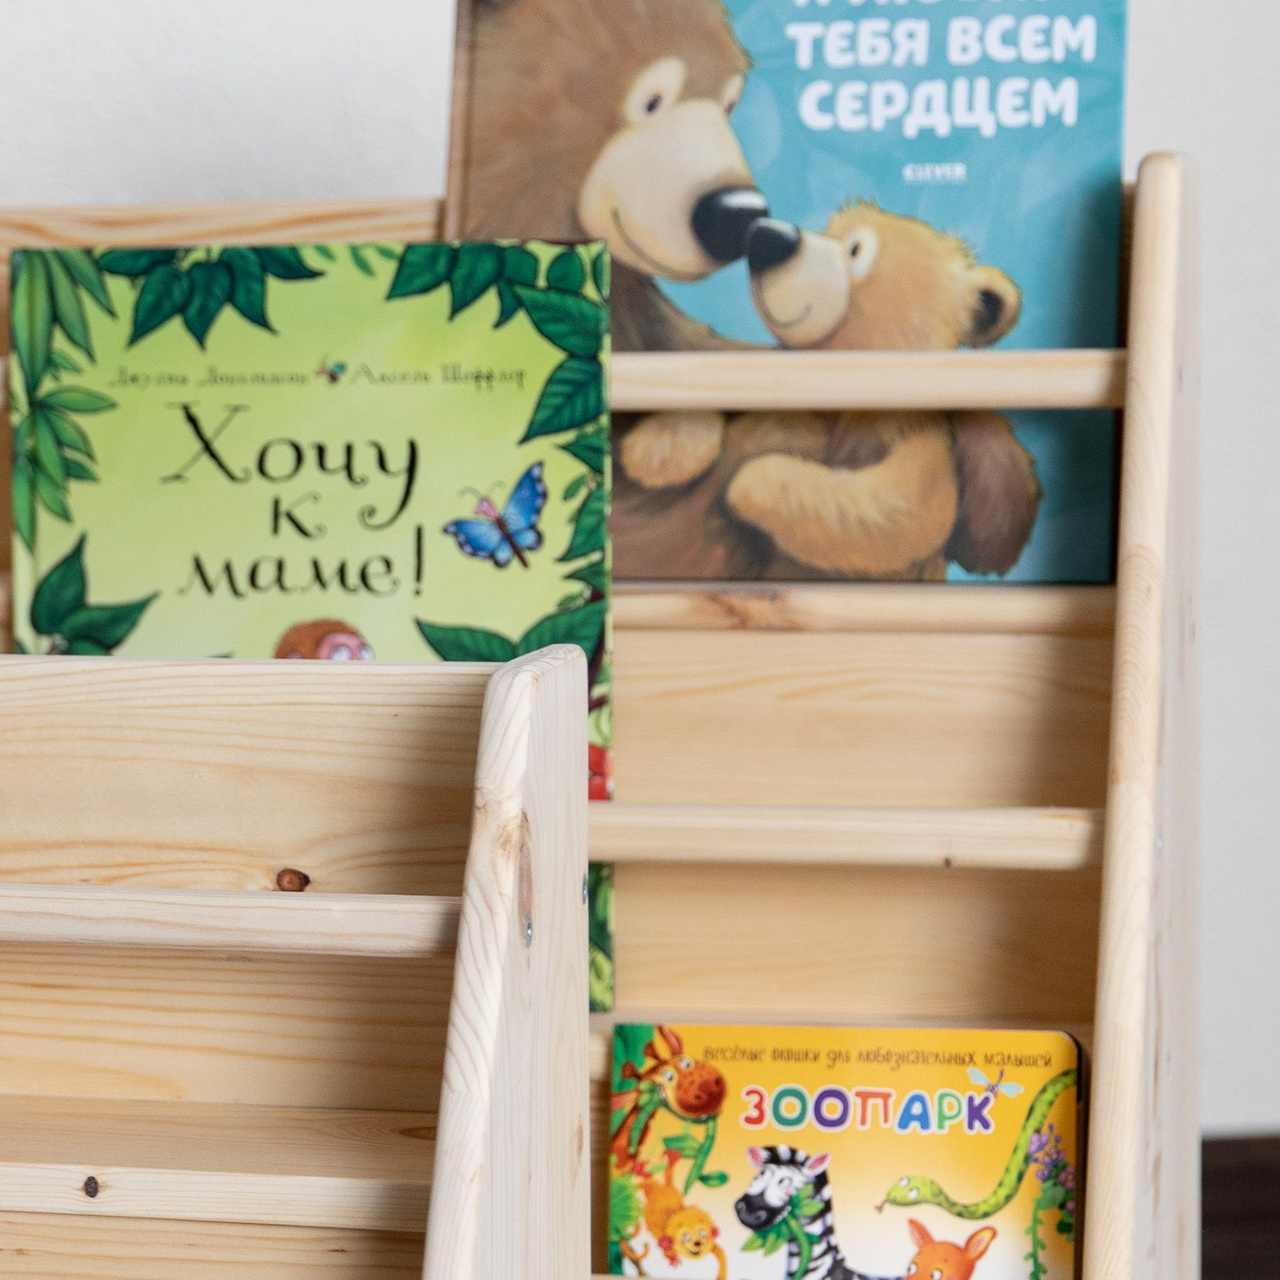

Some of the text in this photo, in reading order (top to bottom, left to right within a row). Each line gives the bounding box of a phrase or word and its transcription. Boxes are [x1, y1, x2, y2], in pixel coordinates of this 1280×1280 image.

[785, 14, 1097, 68] ТЕБЯ ВСЕМ
[797, 77, 1079, 138] СЕРДЦЕМ
[160, 402, 420, 530] Хочу
[270, 493, 326, 540] к
[177, 524, 426, 598] маме!
[826, 1049, 851, 1069] для
[742, 1086, 996, 1132] ЗООПАРК
